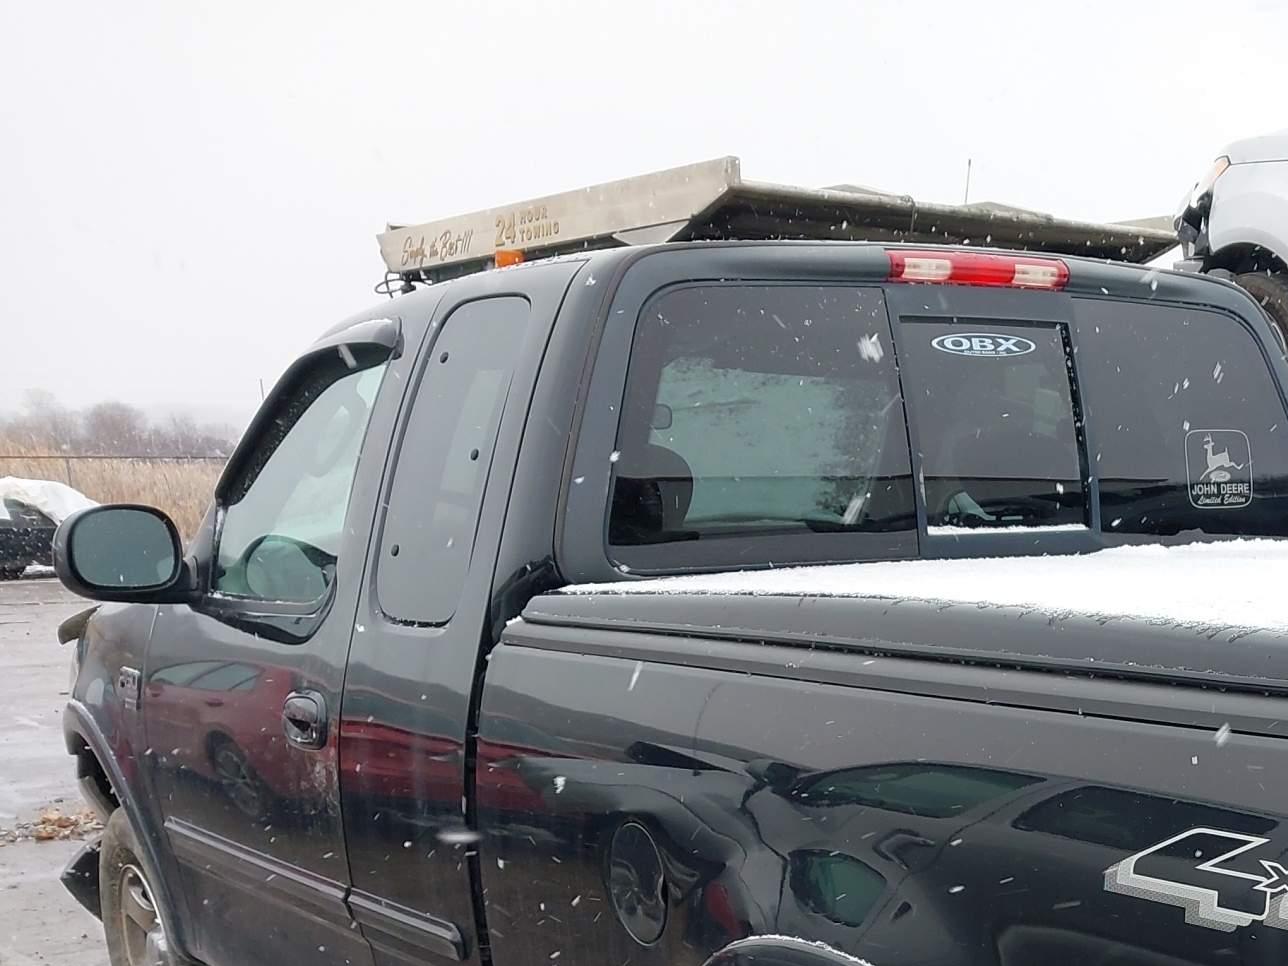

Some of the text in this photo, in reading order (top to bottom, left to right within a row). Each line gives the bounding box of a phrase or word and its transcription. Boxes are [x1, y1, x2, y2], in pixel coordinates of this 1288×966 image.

[496, 206, 547, 246] 24 HOUR
[519, 221, 560, 242] TOWING
[943, 337, 1020, 352] OBX
[1192, 483, 1250, 495] JOHN DEERE
